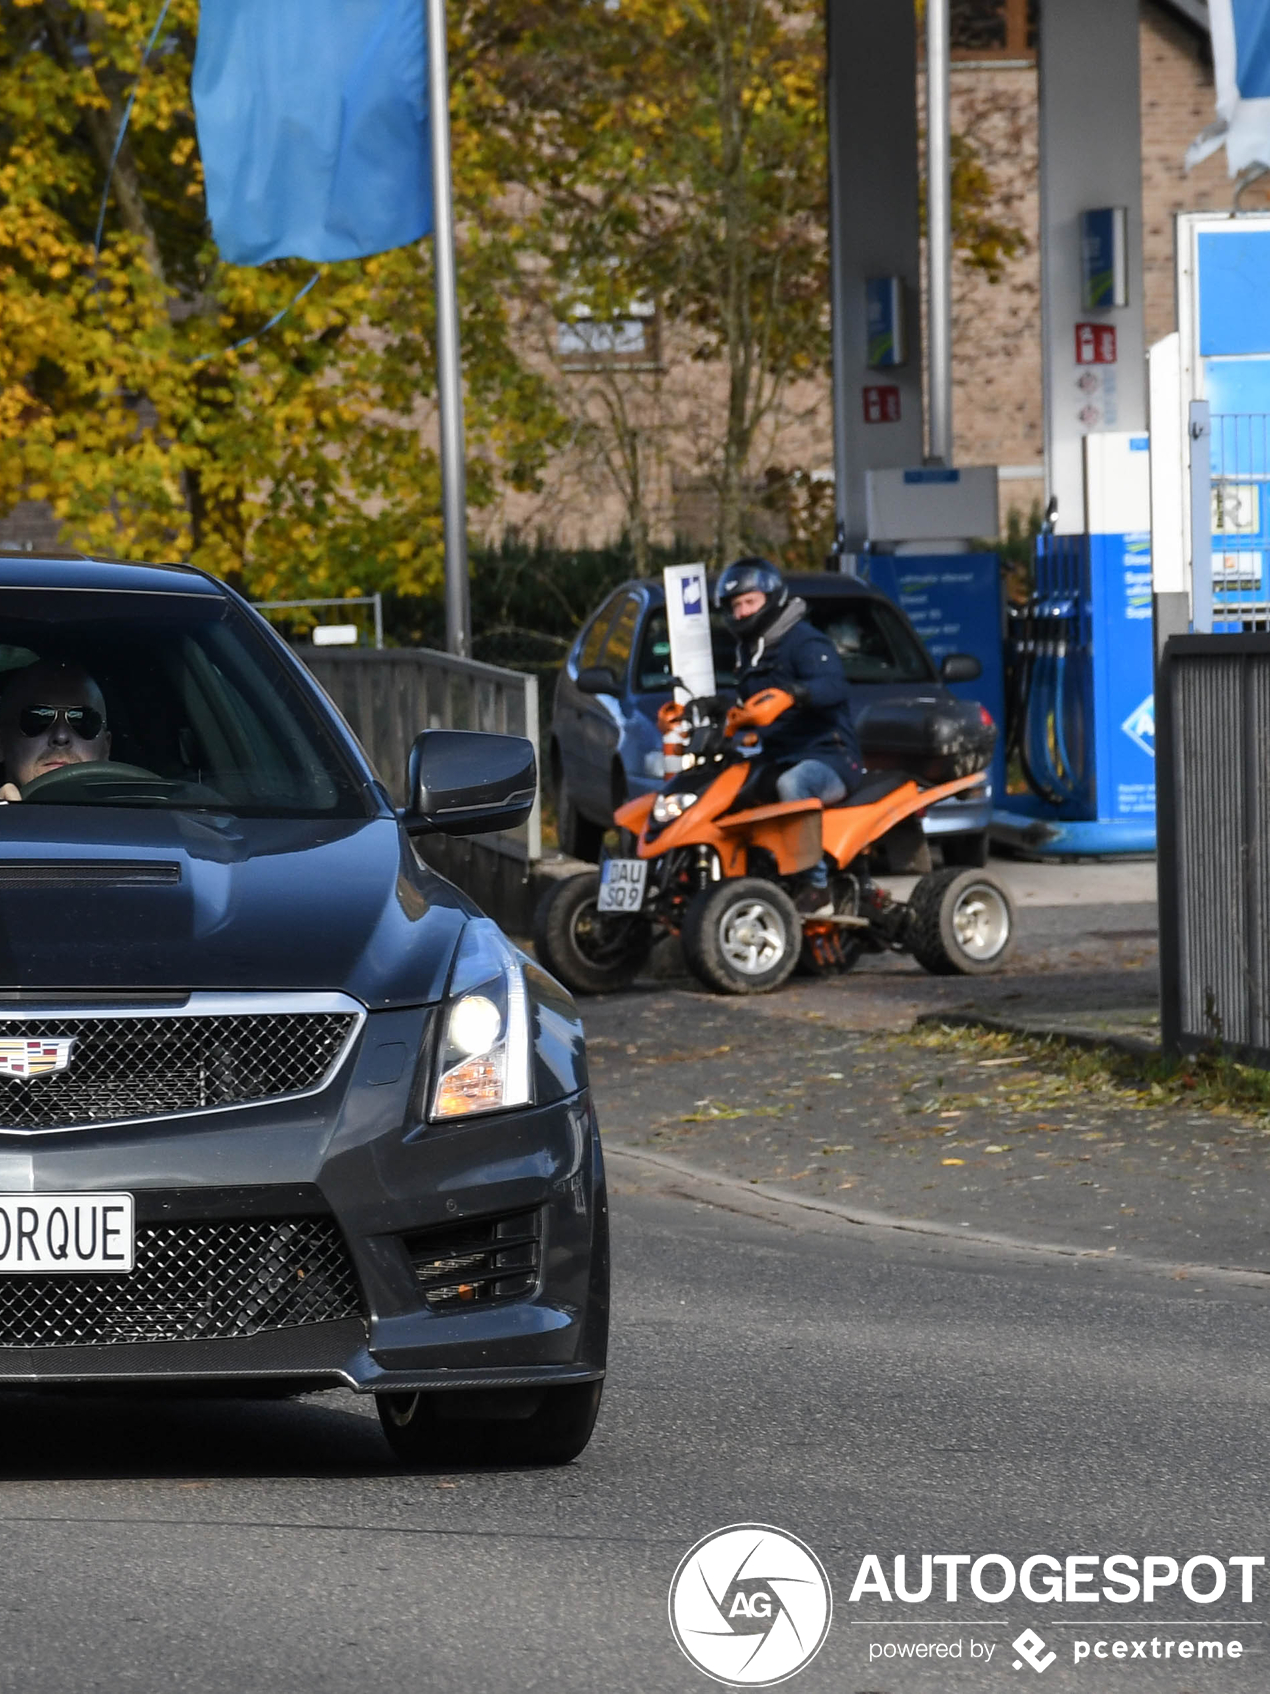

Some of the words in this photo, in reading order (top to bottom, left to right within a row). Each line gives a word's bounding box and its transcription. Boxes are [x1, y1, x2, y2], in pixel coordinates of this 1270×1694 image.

[611, 863, 642, 884] DAU
[605, 887, 627, 907] SQ
[629, 886, 639, 907] 9
